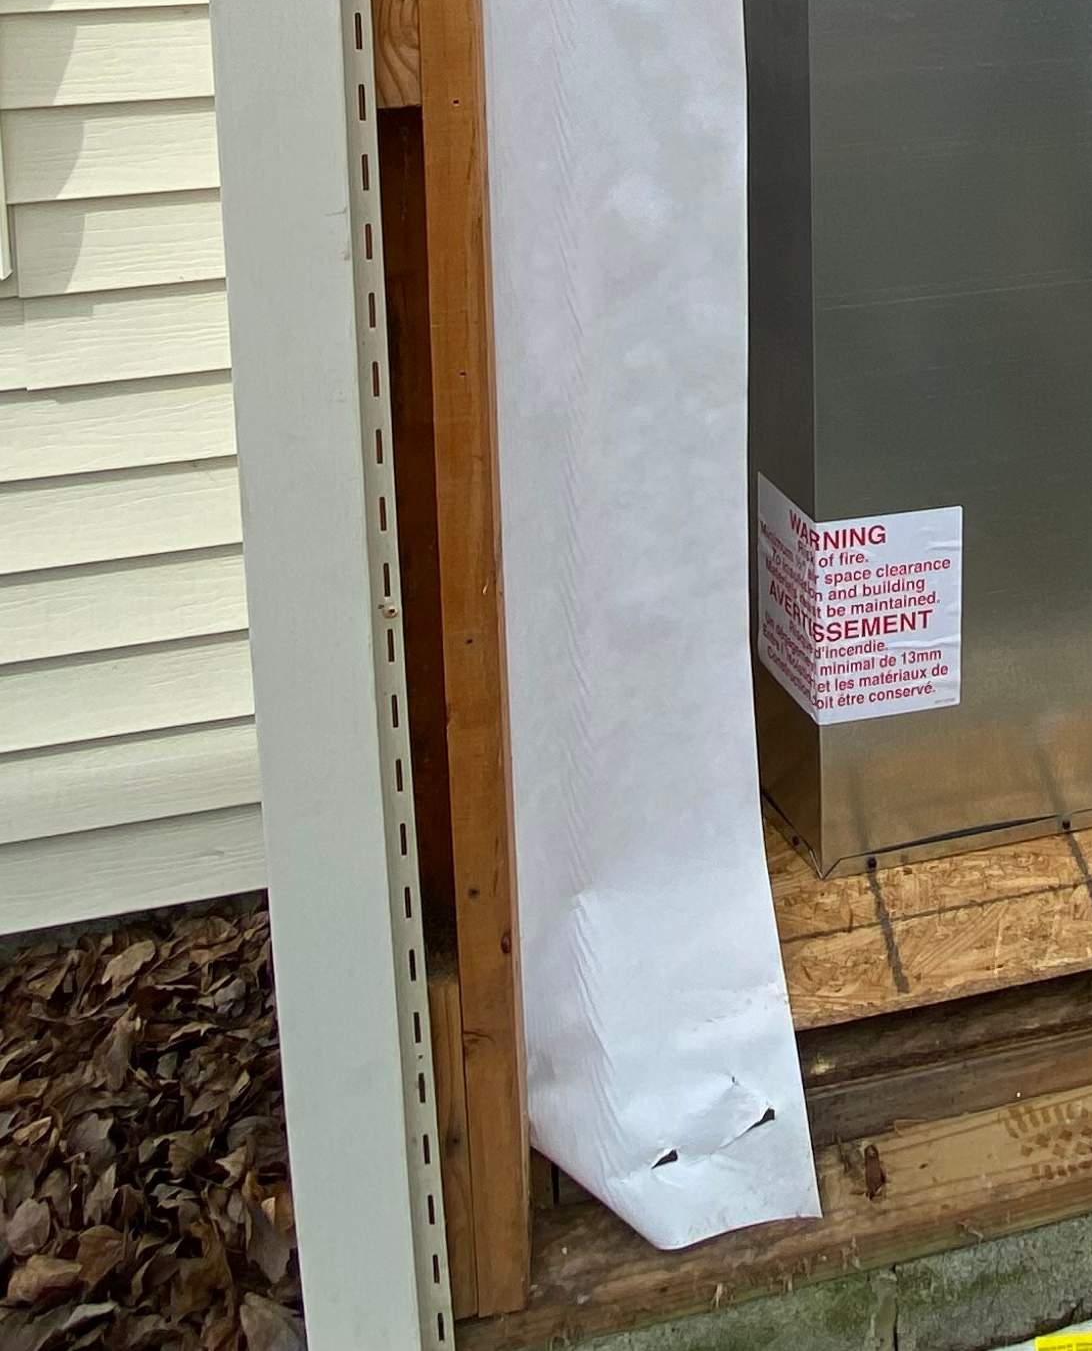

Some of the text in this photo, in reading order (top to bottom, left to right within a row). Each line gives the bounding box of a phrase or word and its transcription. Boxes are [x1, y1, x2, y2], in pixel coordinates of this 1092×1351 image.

[789, 509, 887, 551] WARNING
[818, 552, 837, 568] of
[840, 551, 869, 566] fire.
[824, 568, 871, 589] space
[876, 557, 951, 579] clearance
[828, 585, 857, 602] and
[862, 577, 925, 598] building
[769, 580, 933, 643] AVERTISSEMENT
[827, 601, 846, 618] be
[850, 594, 941, 615] maintained.
[814, 640, 888, 661] d'incendie.
[820, 657, 875, 677] minimal
[879, 653, 897, 668] de
[901, 649, 942, 665] 13mm
[817, 680, 832, 694] et
[834, 675, 855, 690] les
[859, 667, 927, 687] matériaux
[932, 663, 949, 677] de
[837, 689, 865, 706] être
[868, 683, 936, 702] conservé.
